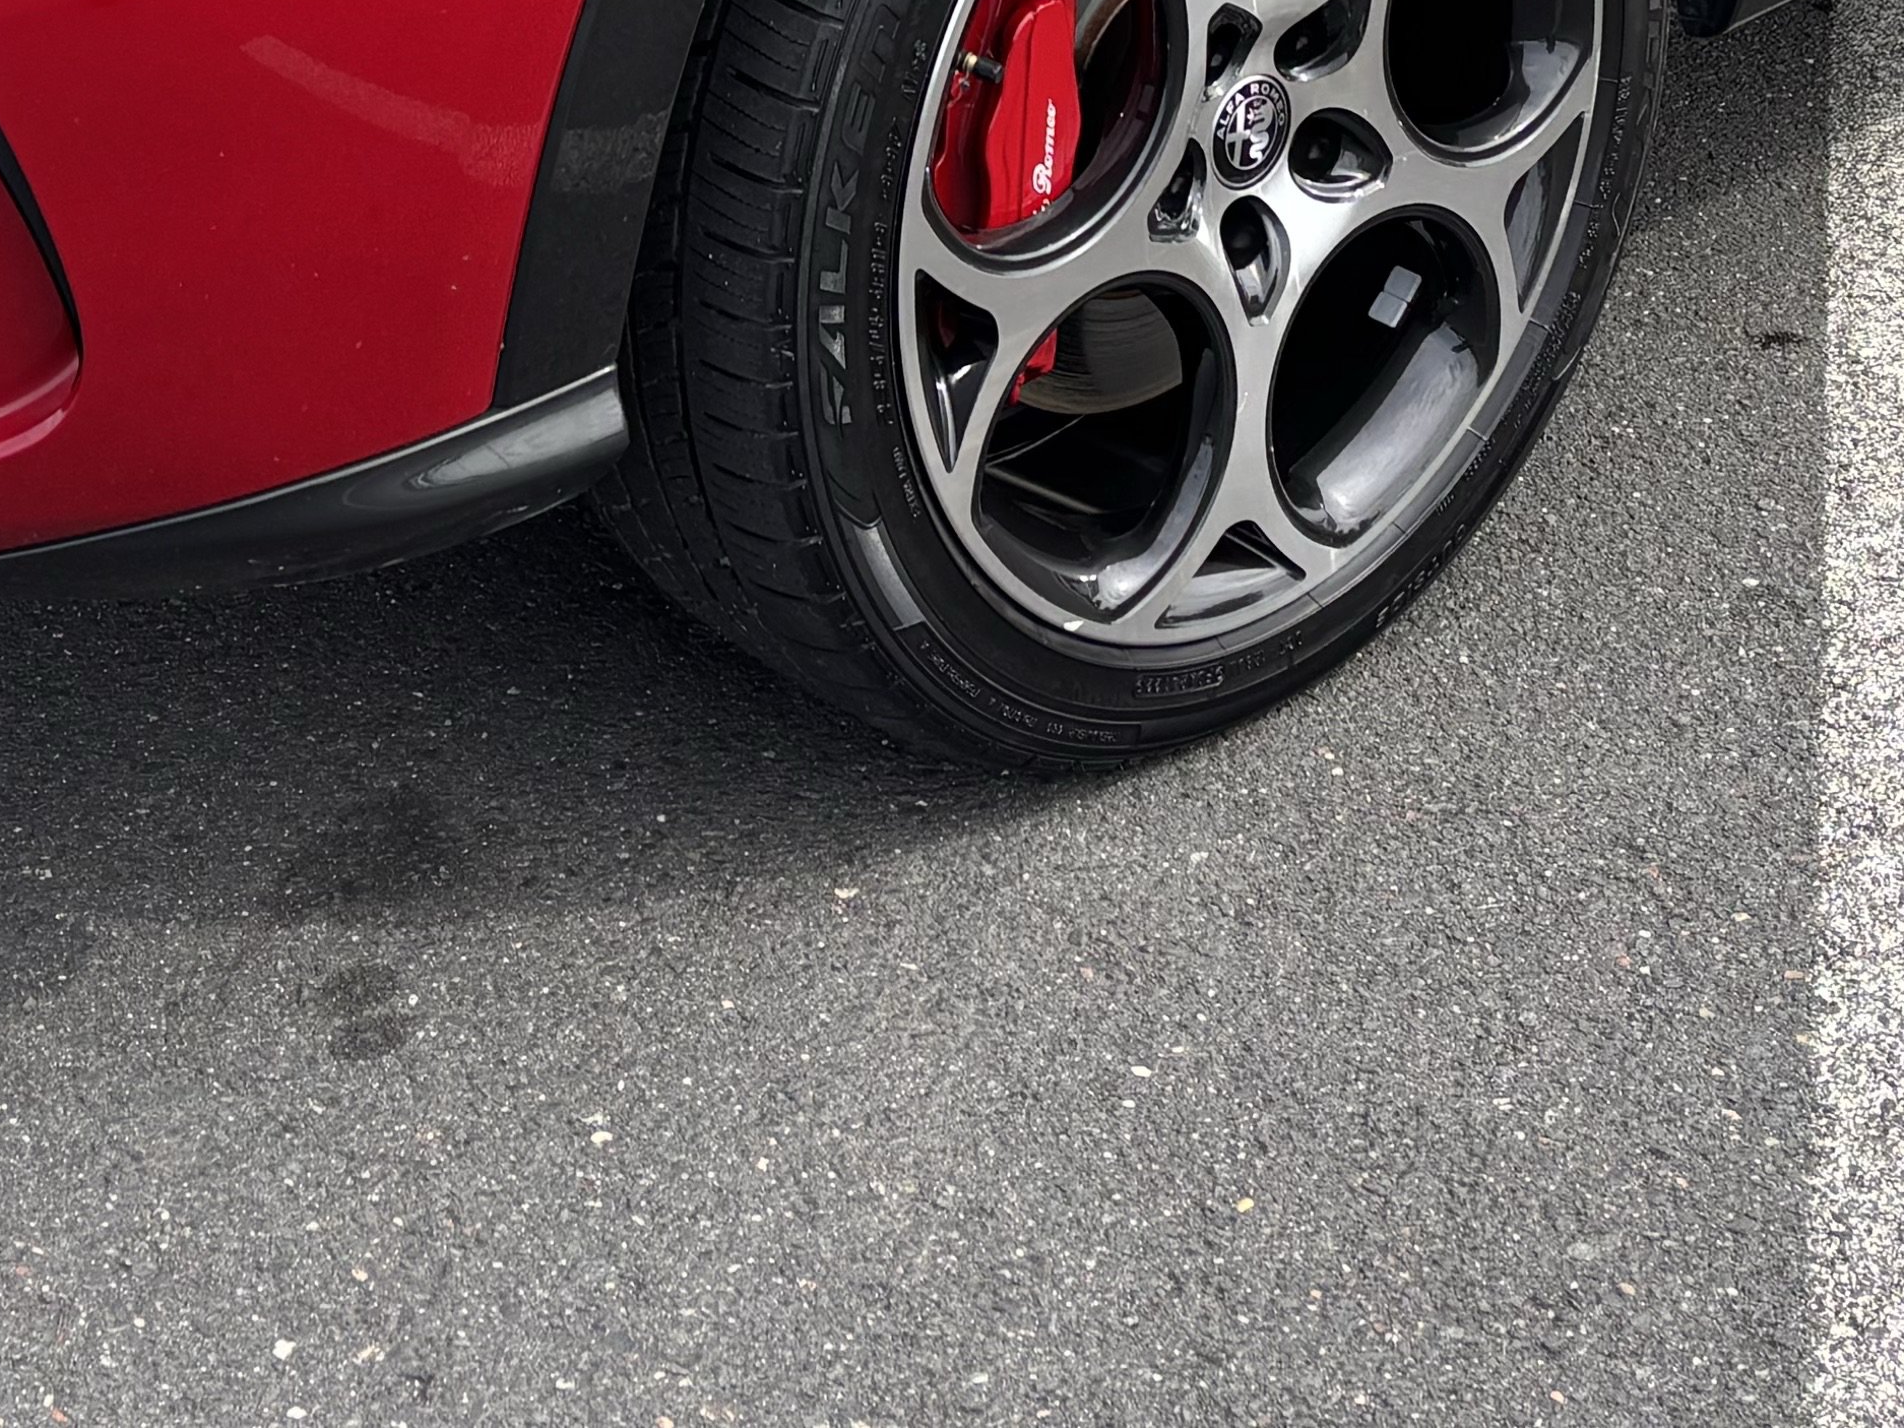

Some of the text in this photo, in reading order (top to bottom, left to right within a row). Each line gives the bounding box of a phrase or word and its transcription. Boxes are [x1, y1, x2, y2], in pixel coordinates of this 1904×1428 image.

[1032, 98, 1055, 194] Romeo
[1216, 82, 1285, 141] ALFA ROMEO
[820, 1, 900, 435] FALKEN
